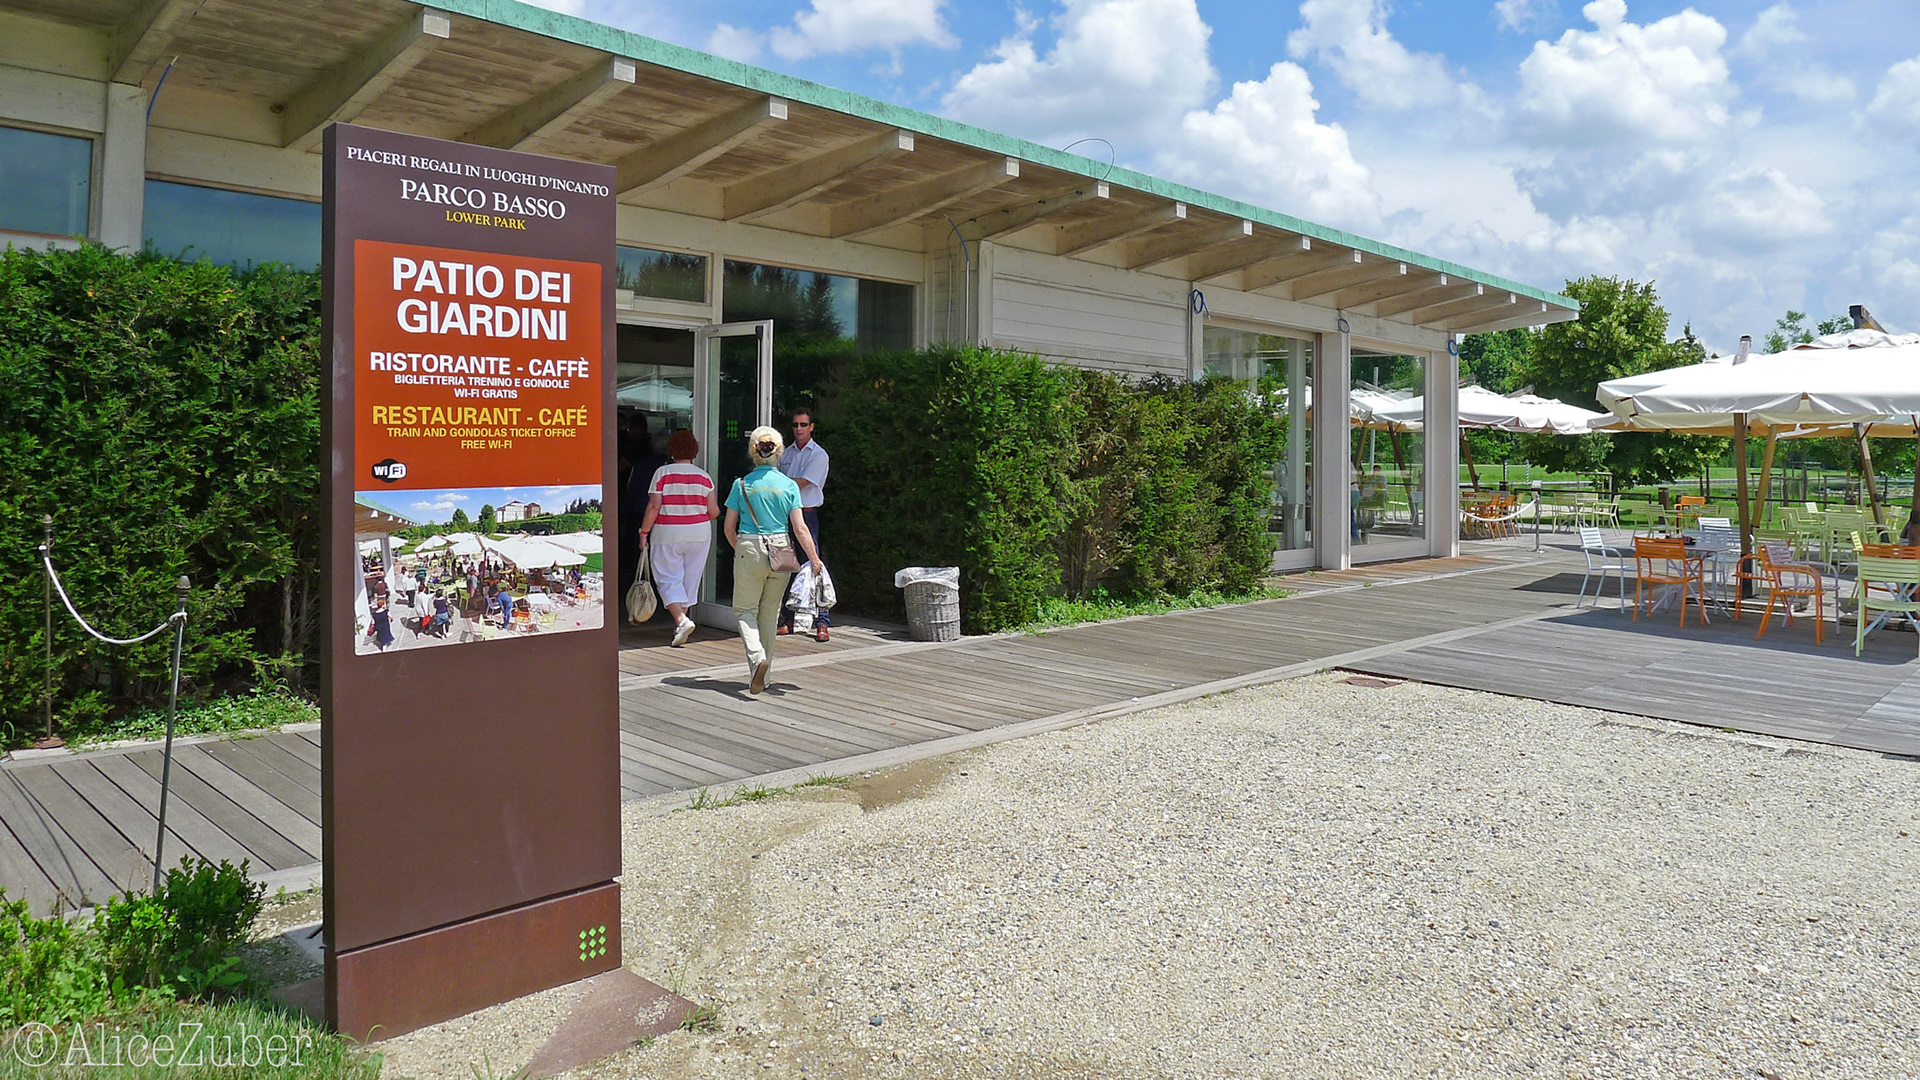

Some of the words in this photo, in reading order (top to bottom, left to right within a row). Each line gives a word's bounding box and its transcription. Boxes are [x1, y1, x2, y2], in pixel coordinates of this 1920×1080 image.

[346, 146, 407, 167] PIACERI
[410, 156, 462, 175] REGALI
[465, 164, 480, 177] IN
[483, 167, 537, 186] LUOGHI
[539, 176, 609, 197] D'INCANTO
[400, 178, 486, 208] PARCO
[492, 191, 566, 220] BASSO
[446, 210, 491, 226] LOWER
[494, 216, 526, 231] PARK
[393, 257, 504, 299] PATIO
[515, 268, 571, 304] DEI
[396, 298, 567, 341] GIARDINI
[370, 351, 511, 375] RISTORANTE
[528, 356, 589, 378] CAFFÈ
[394, 374, 465, 386] BIGLIETTERIA
[467, 376, 512, 387] TRENINO
[514, 378, 521, 387] E
[523, 378, 570, 389] GONDOLE
[454, 388, 479, 398] WI-FI
[481, 389, 518, 399] GRATIS
[372, 405, 521, 425] RESTAURANT
[538, 405, 588, 426] CAFÉ
[387, 427, 420, 437] TRAIN
[423, 427, 447, 437] AND
[449, 427, 507, 438] GONDOLAS
[509, 428, 543, 437] TICKET
[544, 428, 576, 438] OFFICE
[461, 440, 486, 449] FREE
[488, 440, 512, 449] WI-FI
